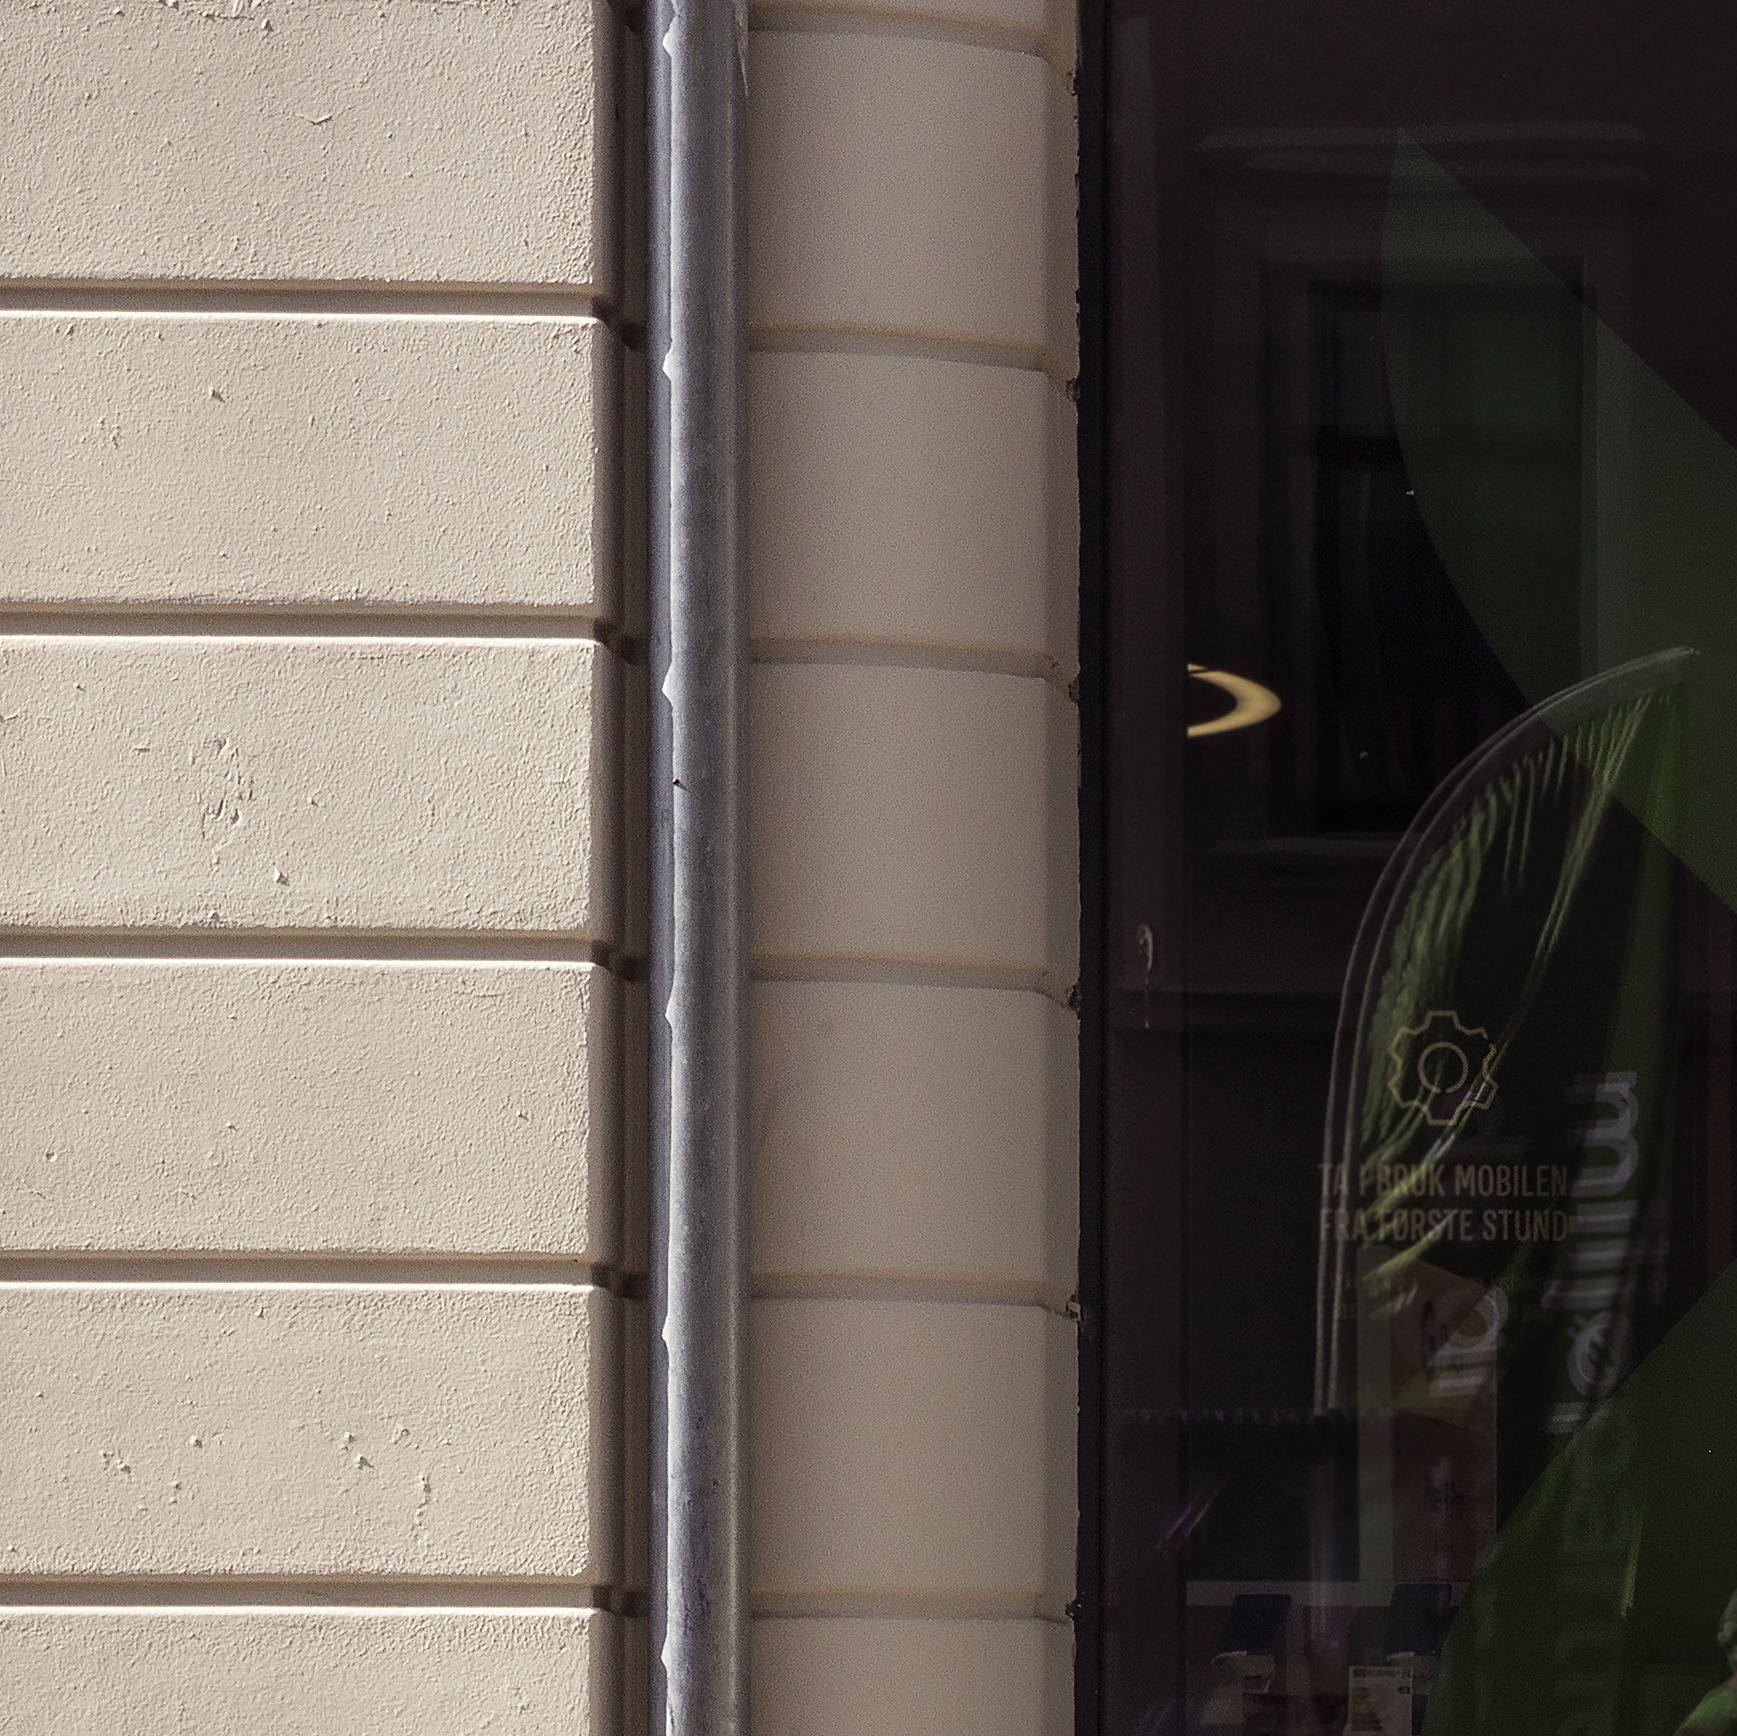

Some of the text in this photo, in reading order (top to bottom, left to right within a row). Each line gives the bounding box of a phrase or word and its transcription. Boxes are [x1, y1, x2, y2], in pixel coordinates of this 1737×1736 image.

[1376, 1163, 1445, 1197] BRUK
[1454, 1163, 1568, 1197] MOBILEN
[1311, 1208, 1569, 1242] FRA FØRSTE STUND
